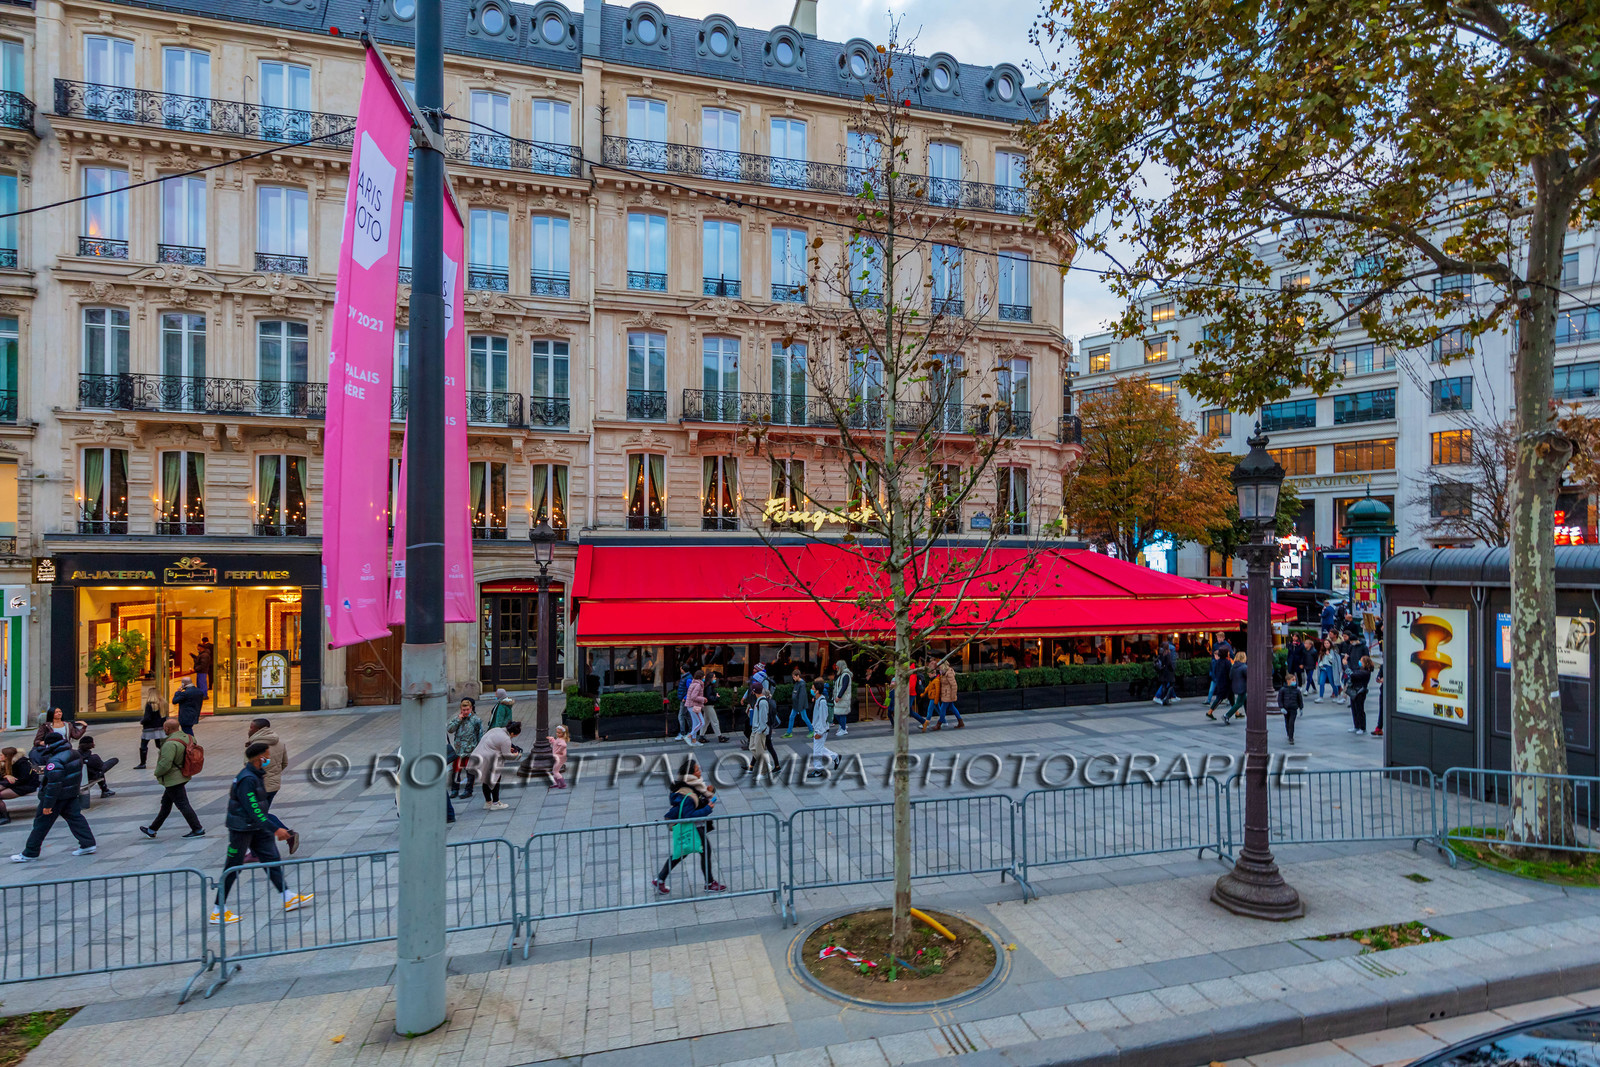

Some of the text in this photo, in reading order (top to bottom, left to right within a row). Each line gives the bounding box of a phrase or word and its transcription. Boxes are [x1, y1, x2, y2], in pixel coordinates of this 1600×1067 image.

[357, 170, 383, 212] ARIS
[357, 312, 384, 332] 2021
[345, 362, 380, 384] PALAIS
[444, 376, 455, 386] 21
[1281, 473, 1372, 489] OUIS VUITTON
[71, 570, 156, 580] AL-JAZEERA
[225, 570, 290, 580] PERFUMES
[246, 791, 267, 822] SWOOSH
